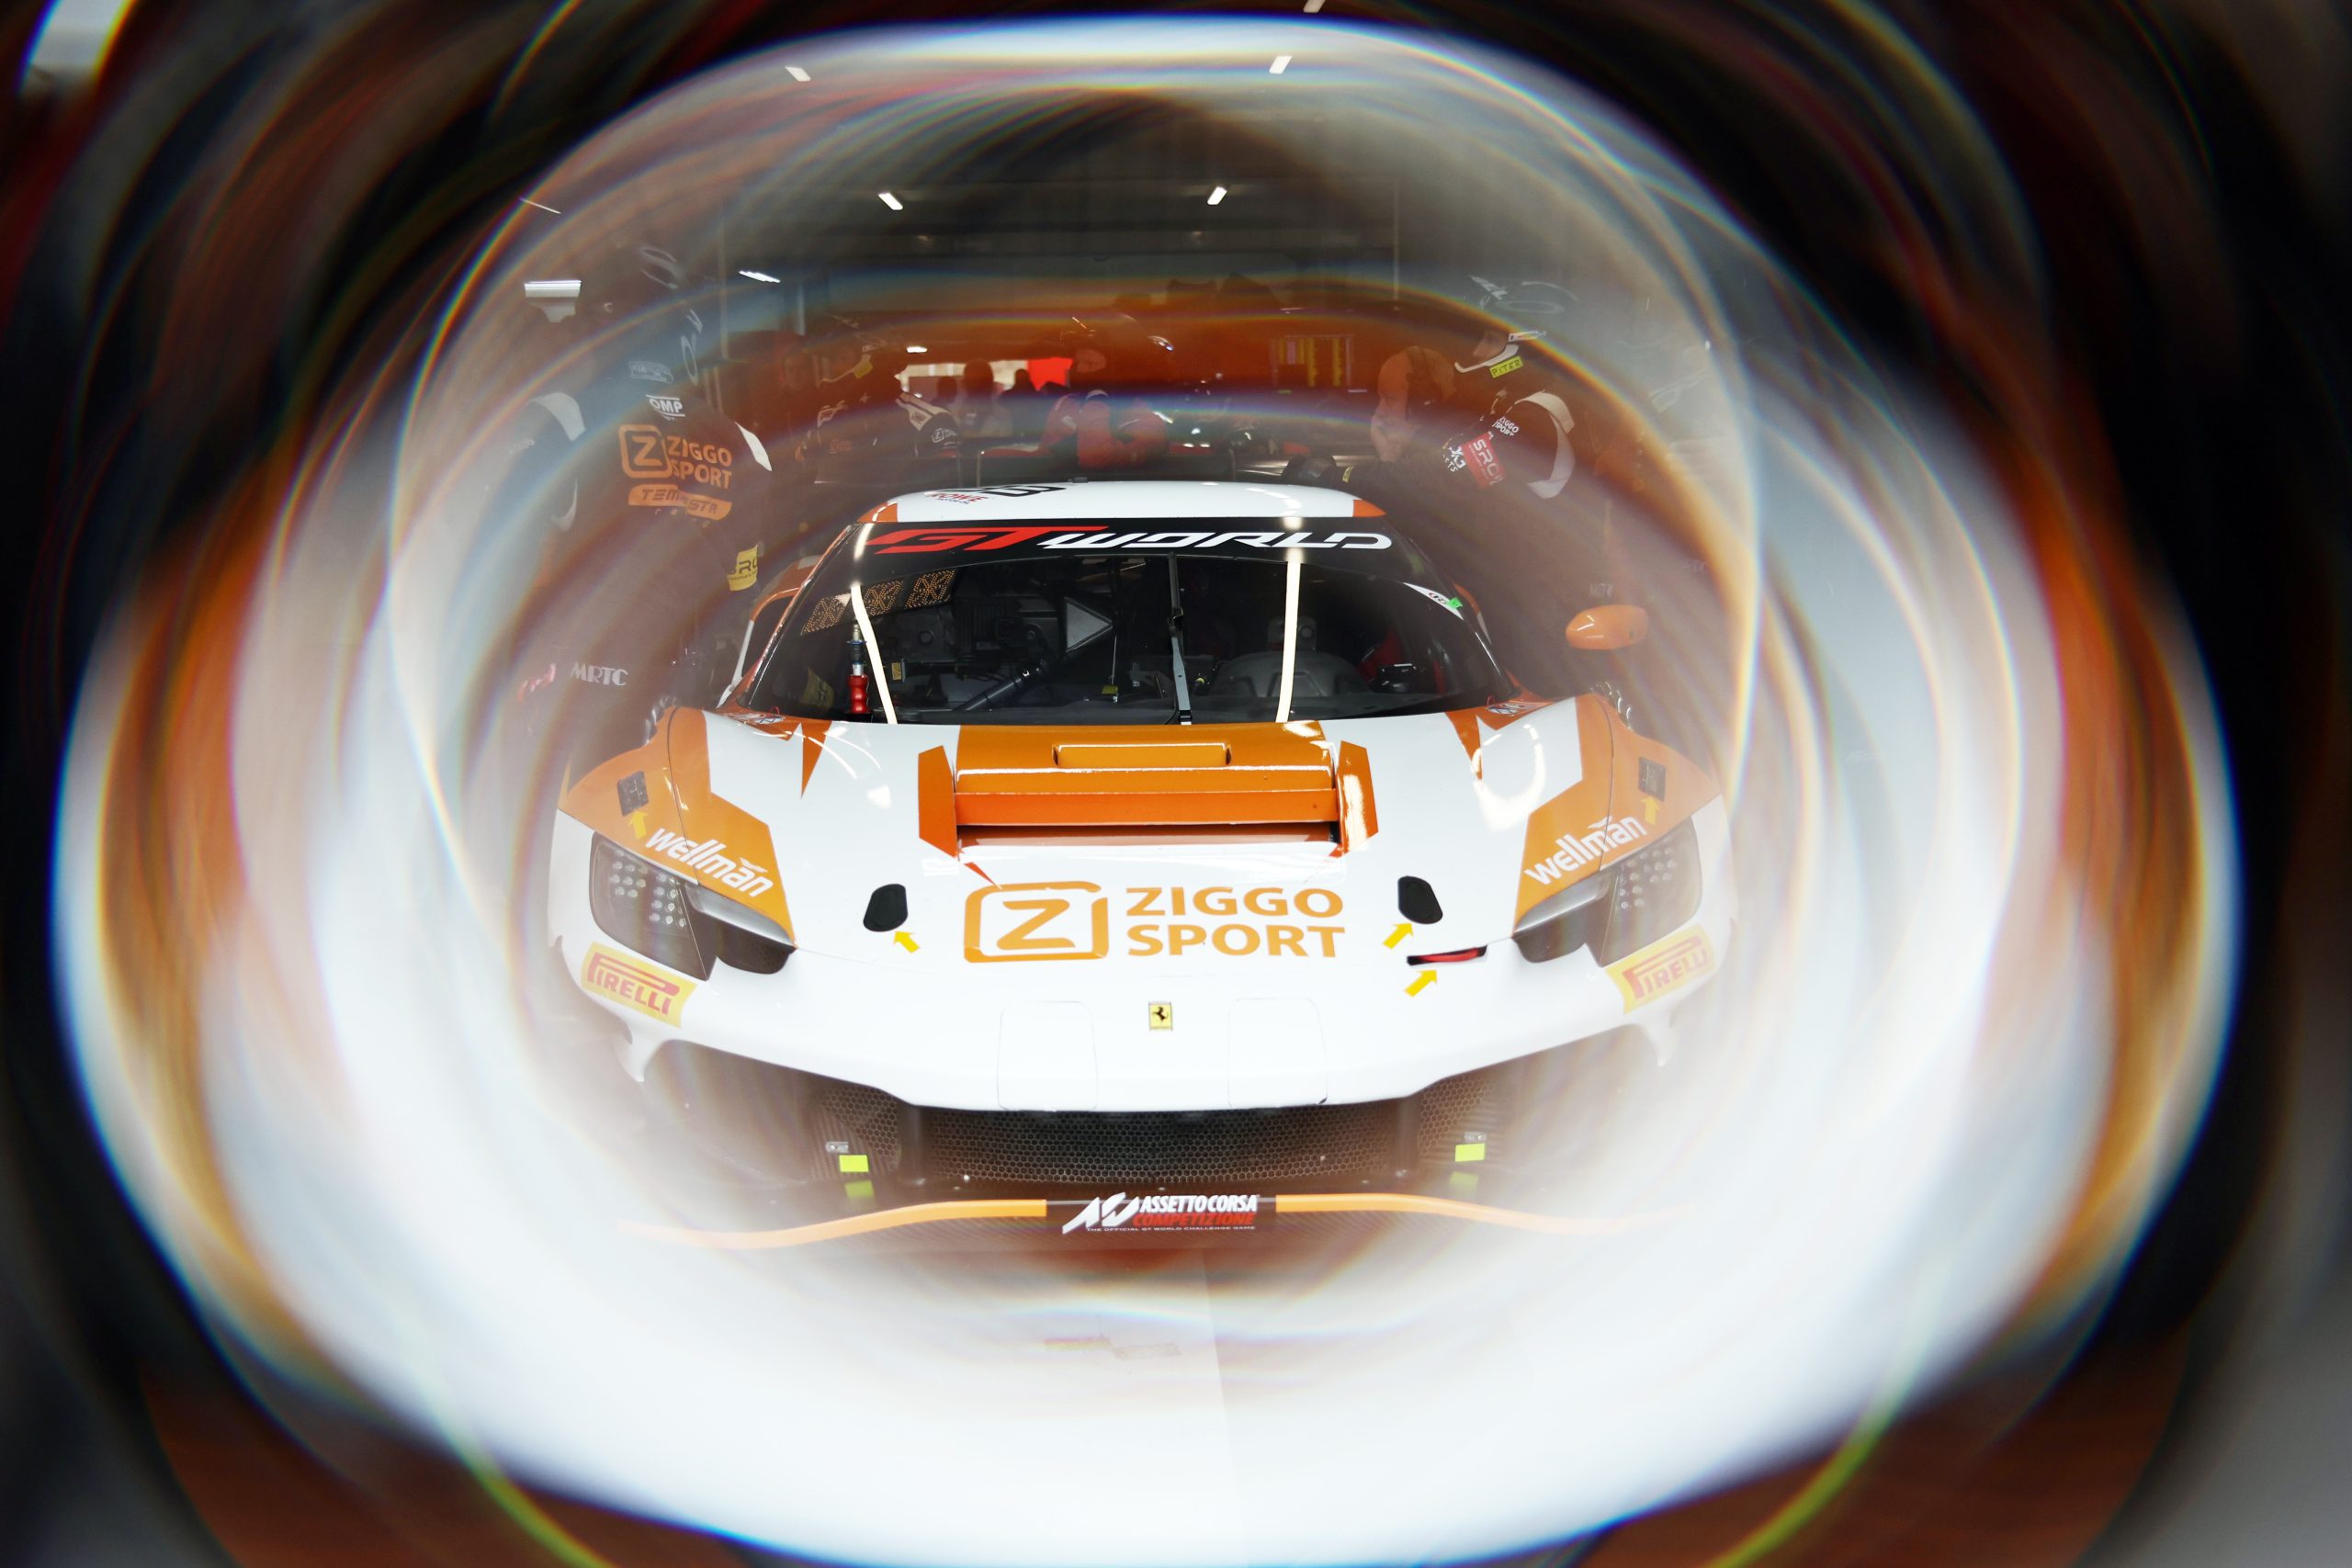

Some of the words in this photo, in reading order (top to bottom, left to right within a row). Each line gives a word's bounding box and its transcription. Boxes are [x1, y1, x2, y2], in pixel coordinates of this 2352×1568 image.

[649, 398, 684, 413] OMP
[667, 435, 732, 467] ZIGGO
[671, 461, 732, 490] SPORT
[641, 489, 718, 514] TEMSTA
[863, 525, 1109, 554] GT
[1036, 532, 1392, 551] WORLD
[571, 661, 628, 686] MRTC
[1125, 886, 1344, 919] ZIGGO
[1126, 922, 1346, 958] SPORT
[1621, 935, 1709, 1000] PIRELLI
[587, 952, 681, 1015] PIRELLI
[1139, 1195, 1208, 1213] ASSETTO
[1207, 1194, 1258, 1213] CORSA
[1132, 1213, 1256, 1228] COMPETIZIONE
